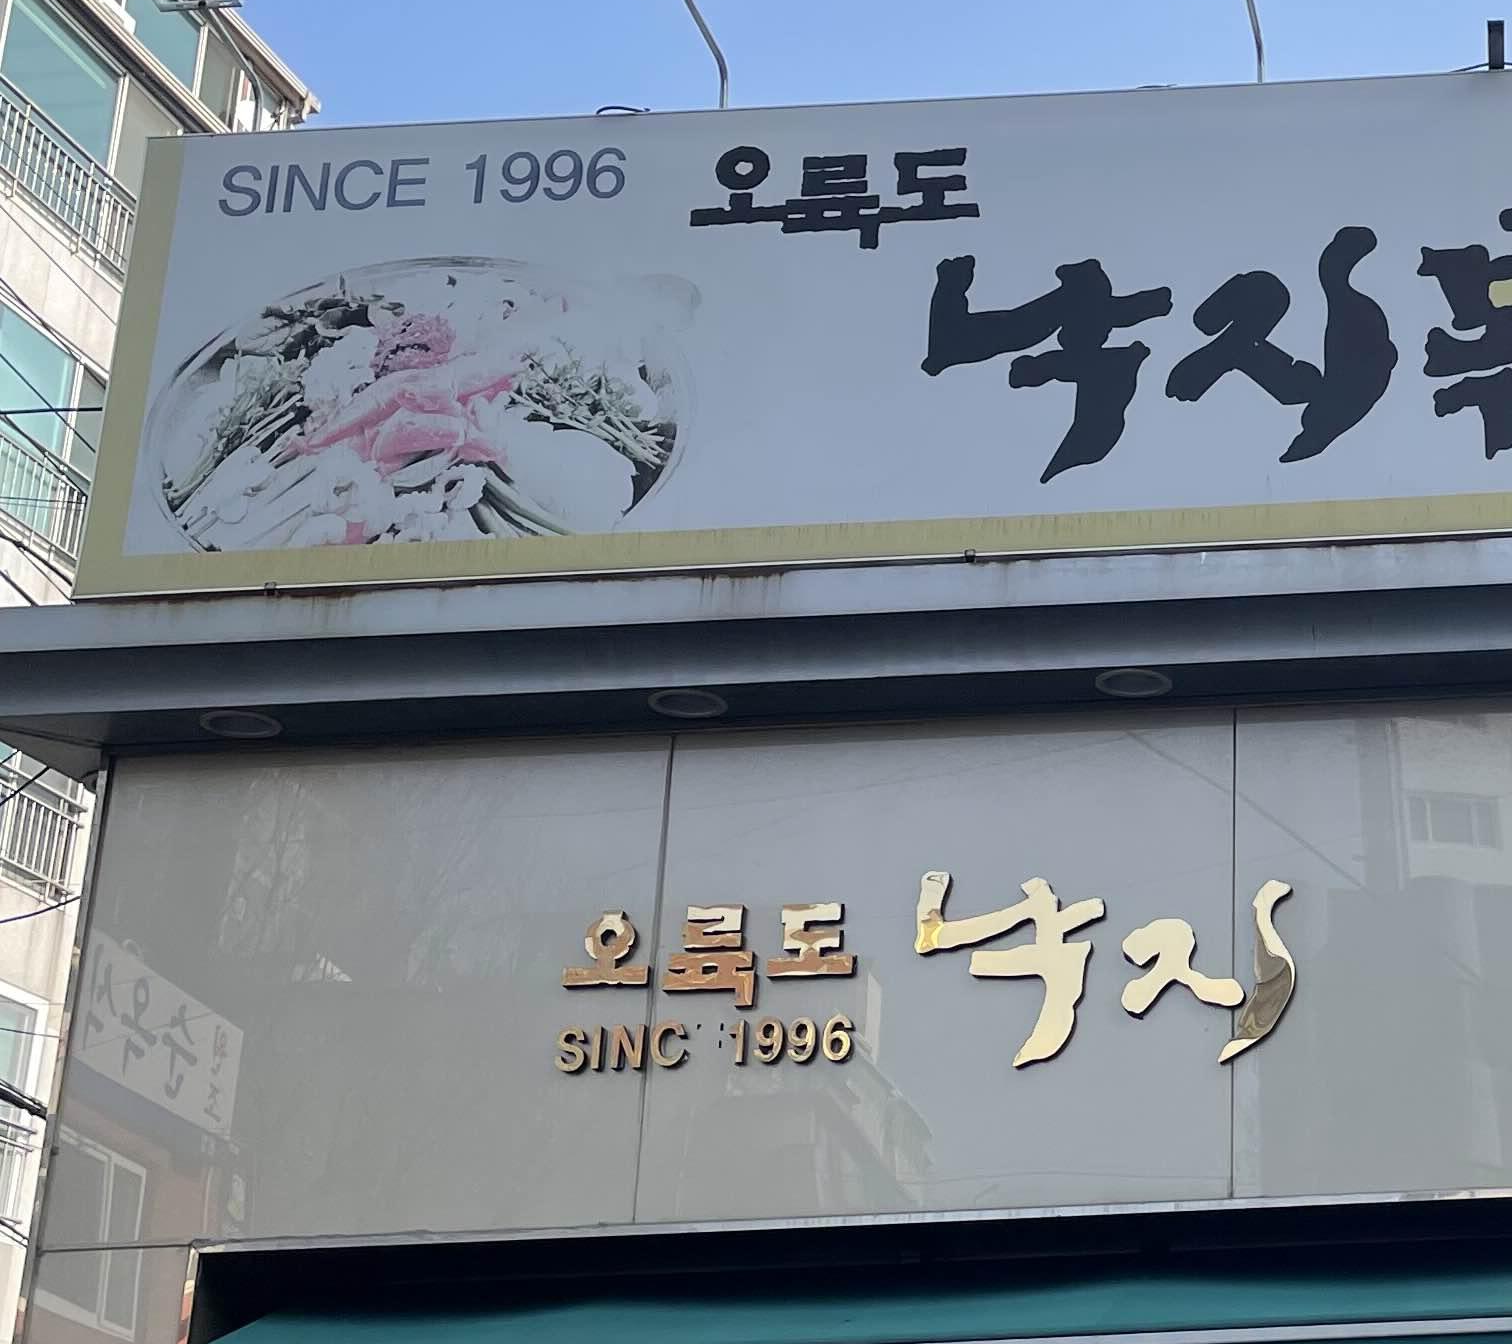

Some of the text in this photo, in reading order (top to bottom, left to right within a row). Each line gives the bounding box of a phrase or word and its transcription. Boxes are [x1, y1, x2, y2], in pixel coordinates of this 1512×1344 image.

[218, 146, 627, 218] SINCE 1996
[689, 145, 981, 250] 오륙도
[562, 902, 858, 1010] 오륙도
[913, 871, 1297, 1069] 낙지
